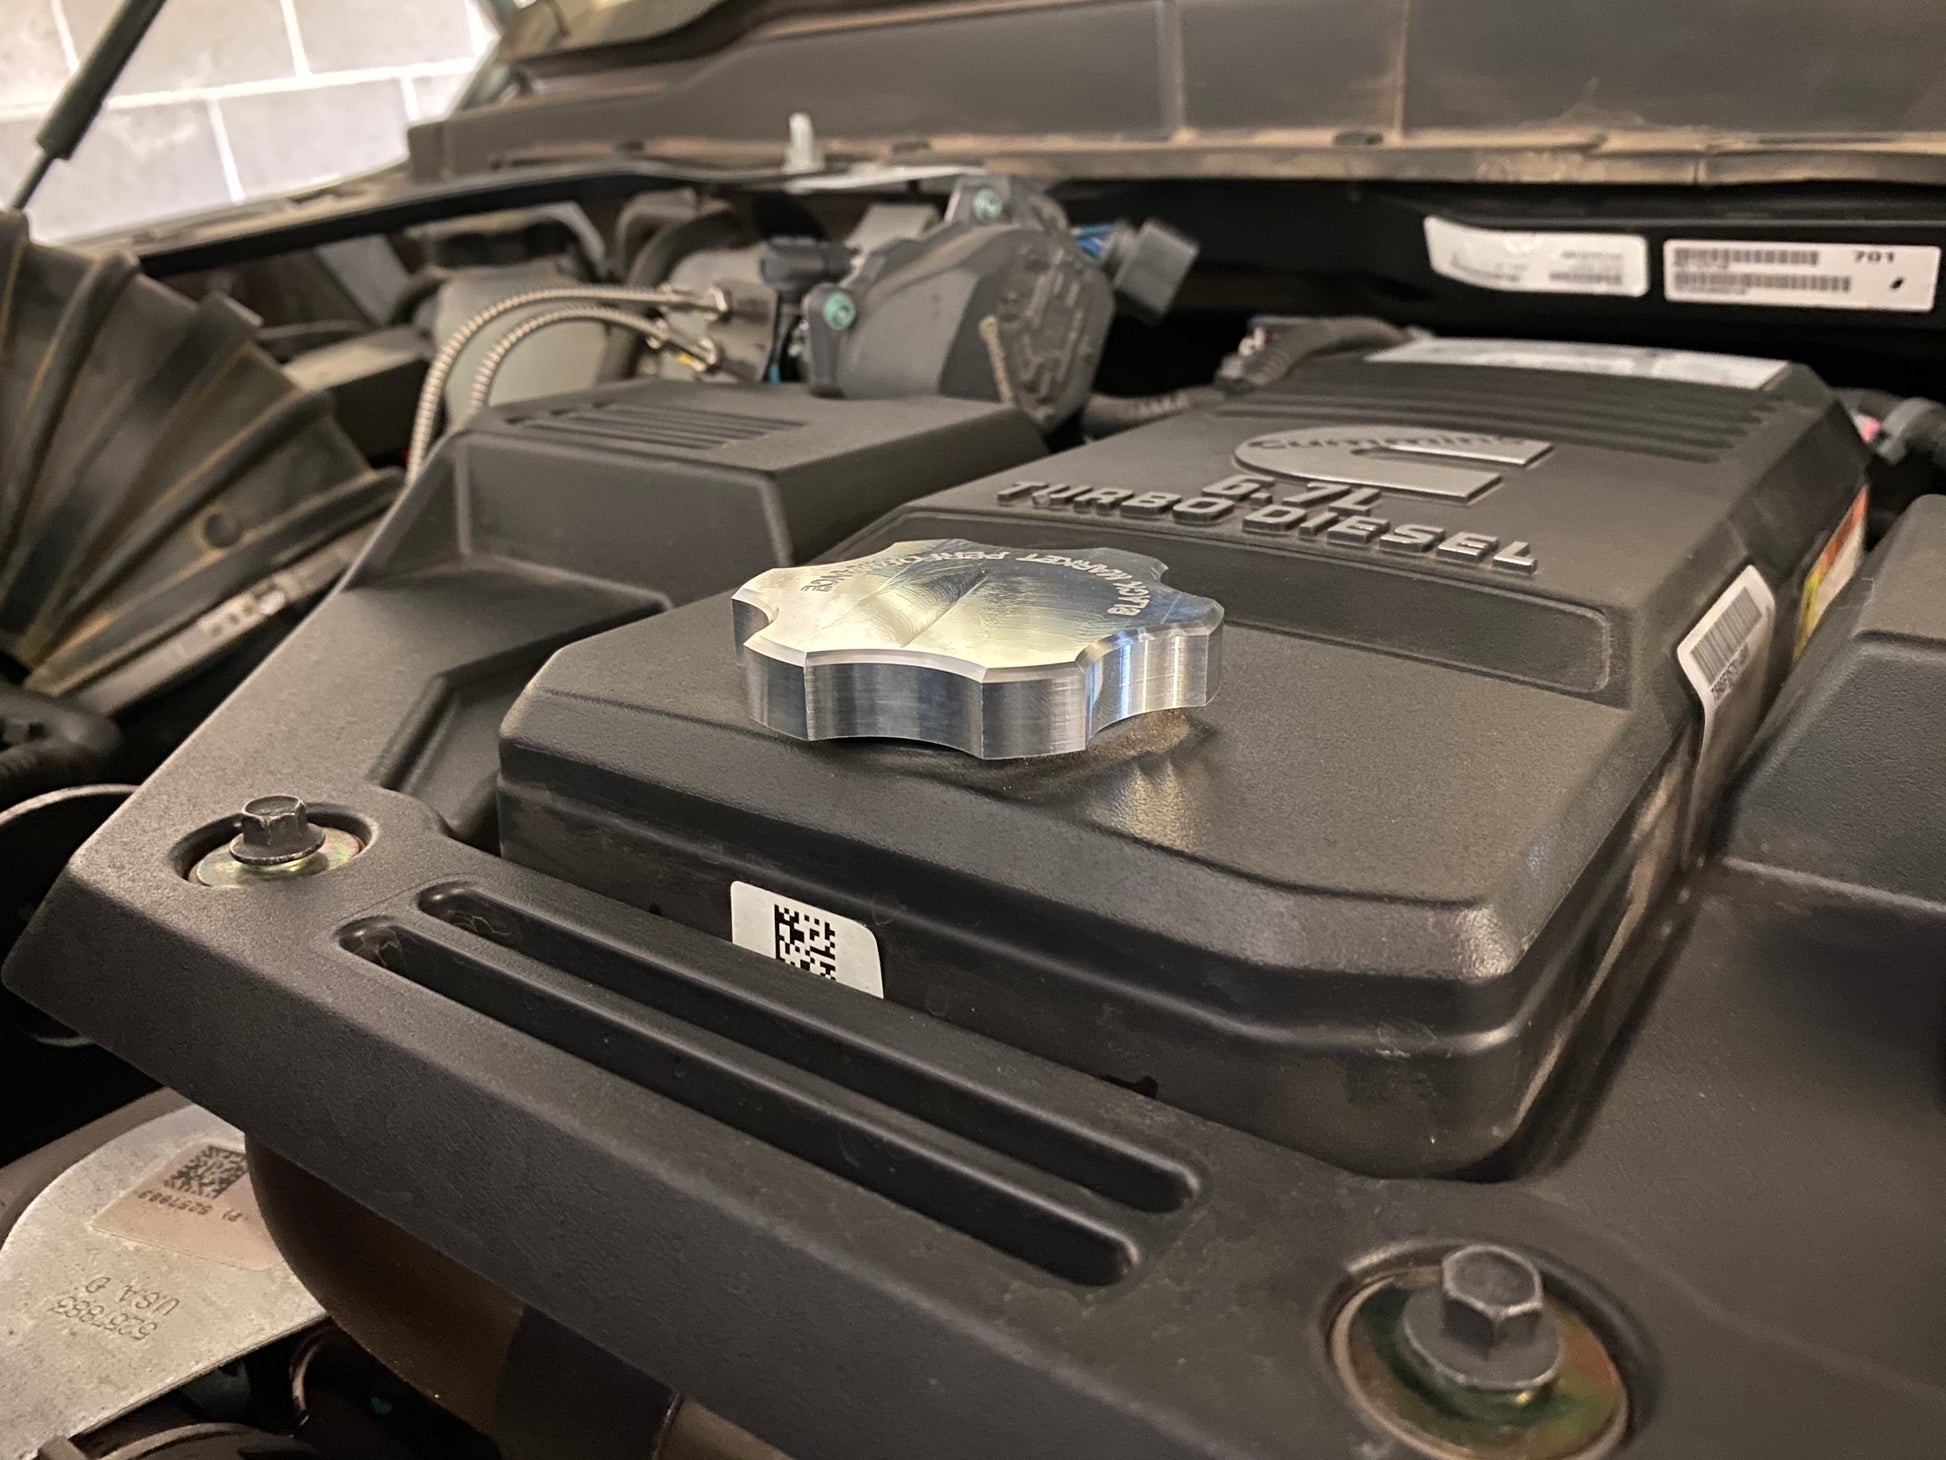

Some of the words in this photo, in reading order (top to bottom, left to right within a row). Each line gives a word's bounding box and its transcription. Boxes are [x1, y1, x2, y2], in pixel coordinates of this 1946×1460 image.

[1201, 475, 1380, 514] 6.7L
[997, 480, 1236, 523] TURBO
[1242, 506, 1538, 574] DIESEL
[1016, 553, 1133, 581] MARKET
[1107, 581, 1151, 616] BLACK
